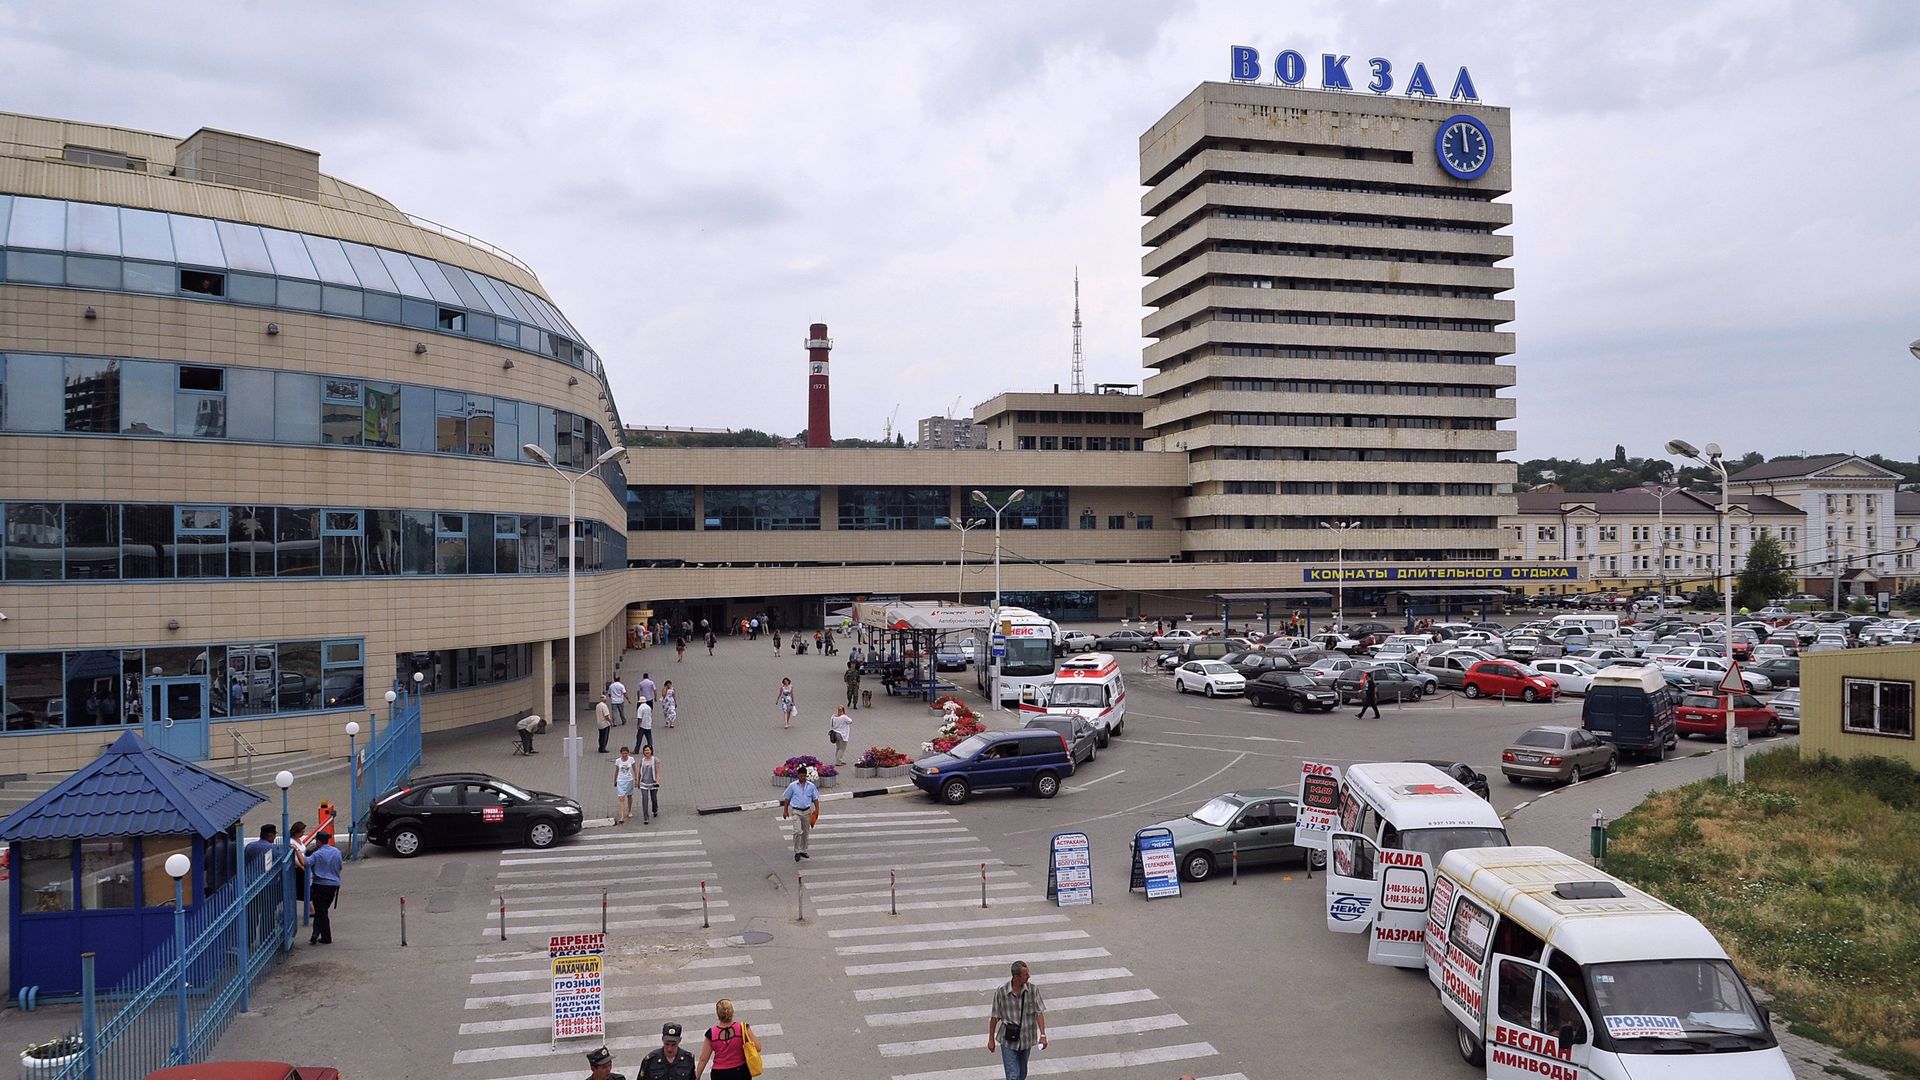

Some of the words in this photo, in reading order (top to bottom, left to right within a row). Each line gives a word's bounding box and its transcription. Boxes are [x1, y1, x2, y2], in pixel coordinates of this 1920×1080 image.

[1231, 45, 1479, 101] ВОКЗАЛ
[1311, 569, 1388, 580] КОМНАТЫ
[1397, 568, 1503, 578] ДЛИТЕЛЬНОГО
[1511, 568, 1569, 578] ОТДЫХА
[1303, 762, 1334, 776] ЕЙС
[1330, 904, 1366, 914] НЕЙС
[550, 933, 605, 946] ДЕРБЕНТ
[550, 943, 606, 952] МАХАЧКАЛА
[550, 950, 587, 958] КАССА
[556, 962, 600, 975] МАХАЧКАЛУ
[555, 979, 601, 989] ГРОЗНЫЙ
[1442, 965, 1481, 1013] ГРОЗНЫЙ
[555, 994, 601, 1002] ПЯТИГОРСК
[555, 999, 601, 1008] НАЛЬЧИК
[555, 1005, 601, 1014] БЕСЛАН
[555, 1011, 601, 1020] НАЗРАНЬ
[1605, 1016, 1681, 1028] ГРОЗНЫЙ
[1495, 1025, 1573, 1062] БЕСЛАН
[1493, 1049, 1578, 1080] МИНВОДЫ
